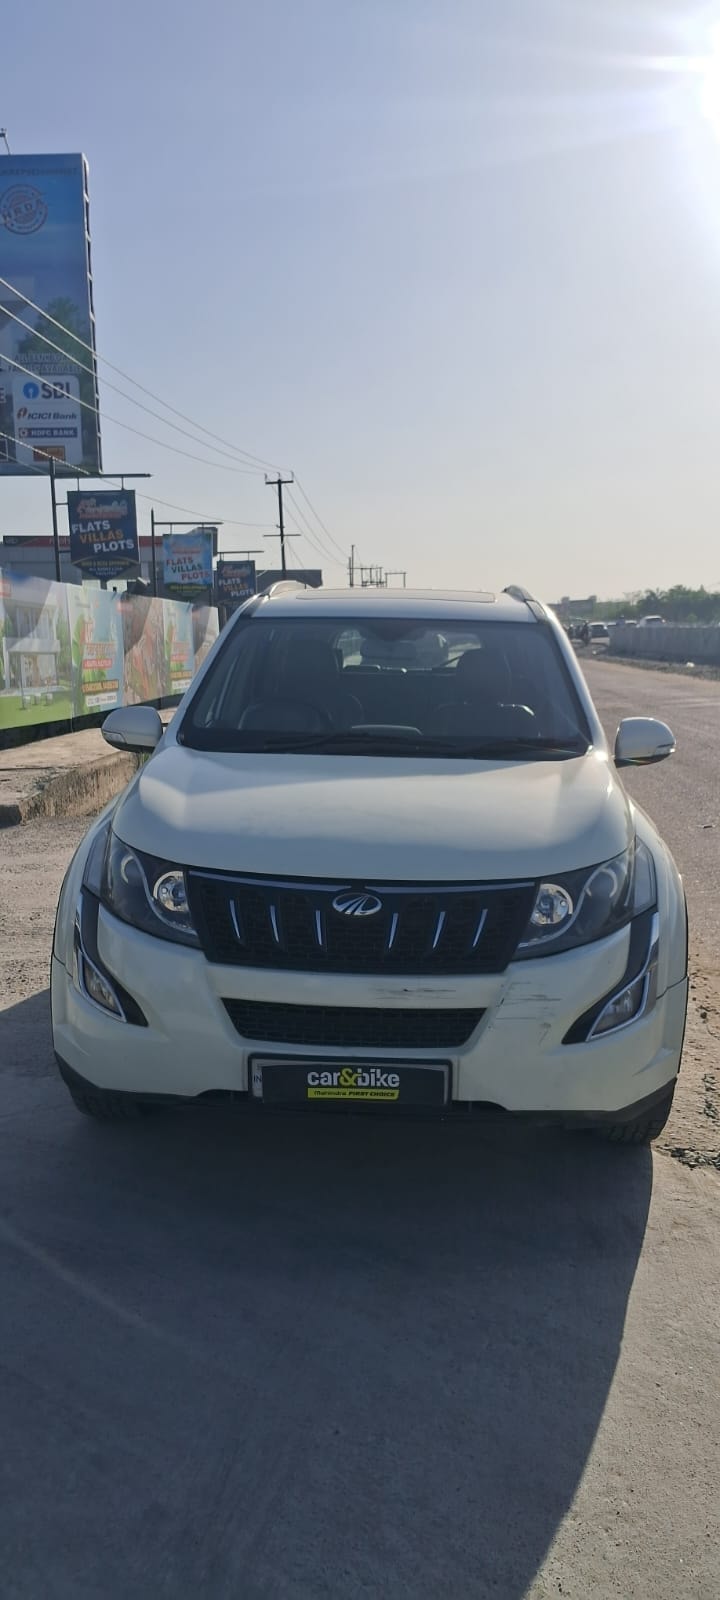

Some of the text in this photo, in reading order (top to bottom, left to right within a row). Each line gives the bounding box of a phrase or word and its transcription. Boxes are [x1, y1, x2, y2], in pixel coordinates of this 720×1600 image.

[41, 382, 71, 399] SBI
[28, 412, 77, 420] ICICI Bank
[71, 520, 110, 534] FLATS
[79, 529, 124, 544] VILLAS
[93, 539, 135, 553] PLOTS
[166, 556, 193, 566] FLATS
[171, 563, 203, 573] VILLAS
[181, 571, 209, 581] PLOTS
[218, 577, 241, 585] FLATS
[223, 583, 248, 592] VILLAS
[231, 589, 254, 597] PLOTS
[307, 1067, 400, 1087] car&bike
